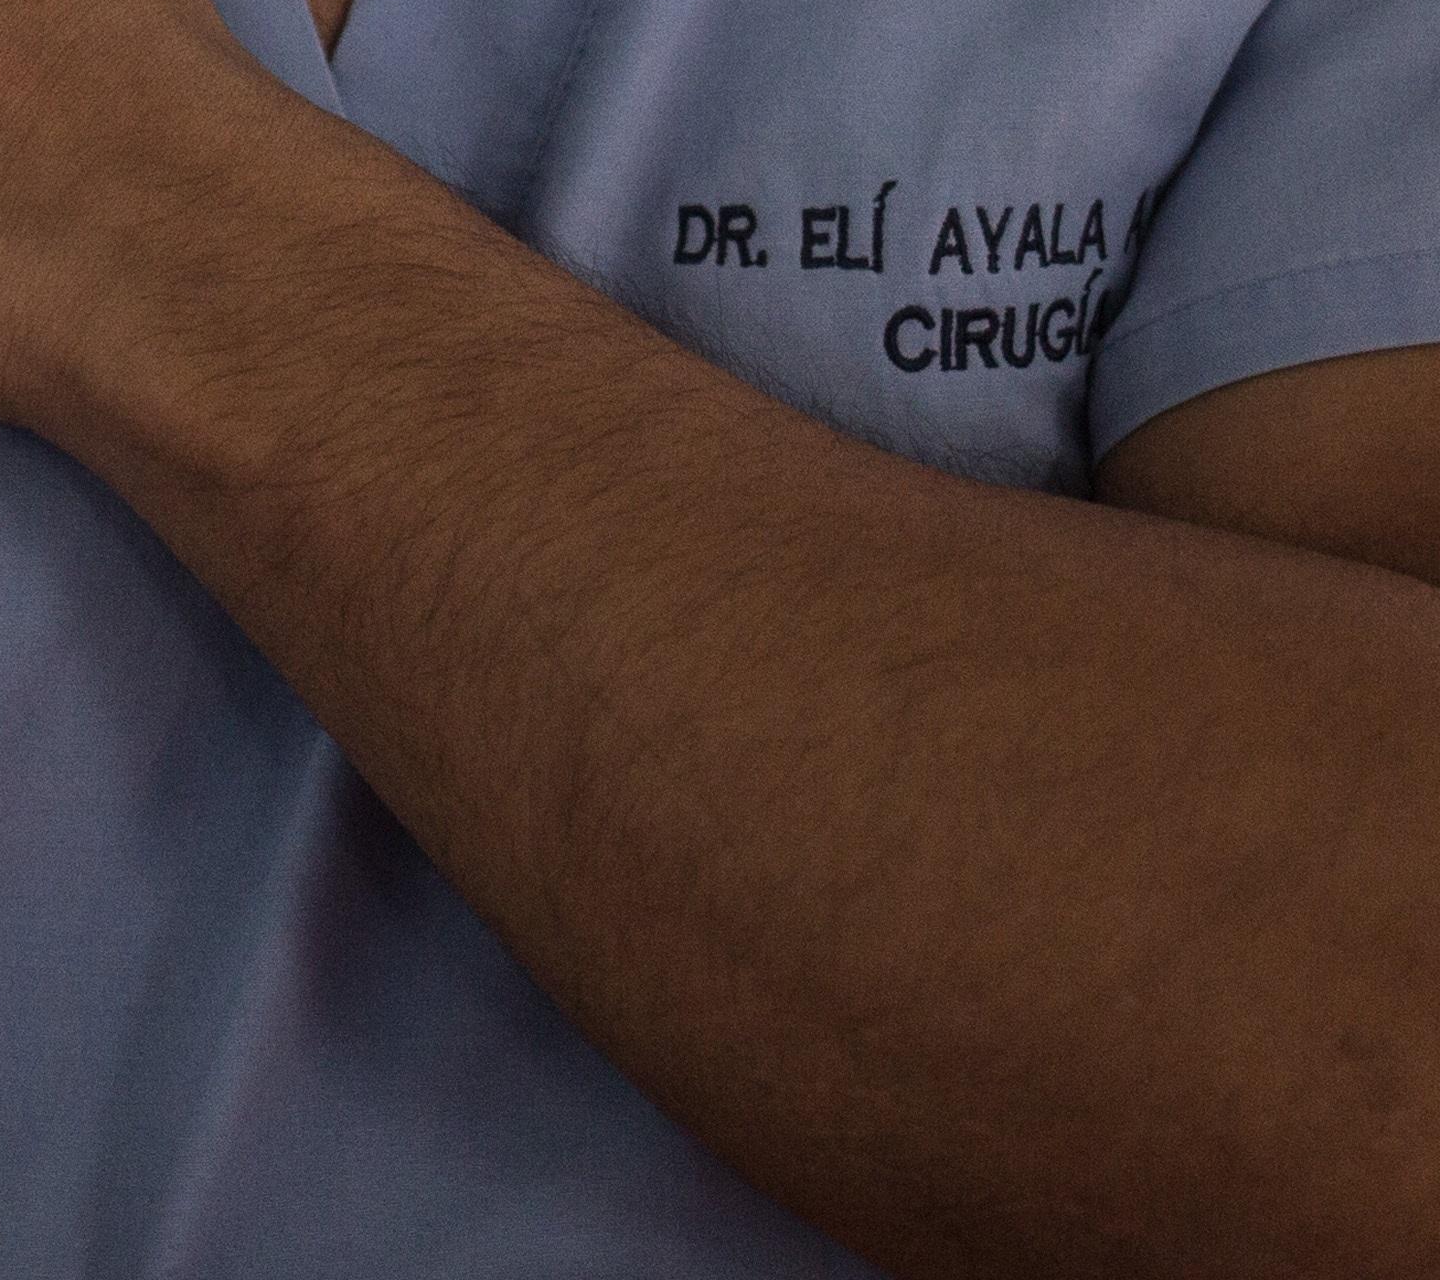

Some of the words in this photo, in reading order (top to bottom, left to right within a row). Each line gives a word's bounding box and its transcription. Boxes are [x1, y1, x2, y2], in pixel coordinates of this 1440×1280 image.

[673, 203, 768, 268] DR.
[800, 179, 898, 274] ELÍ
[927, 198, 1108, 275] AYALA
